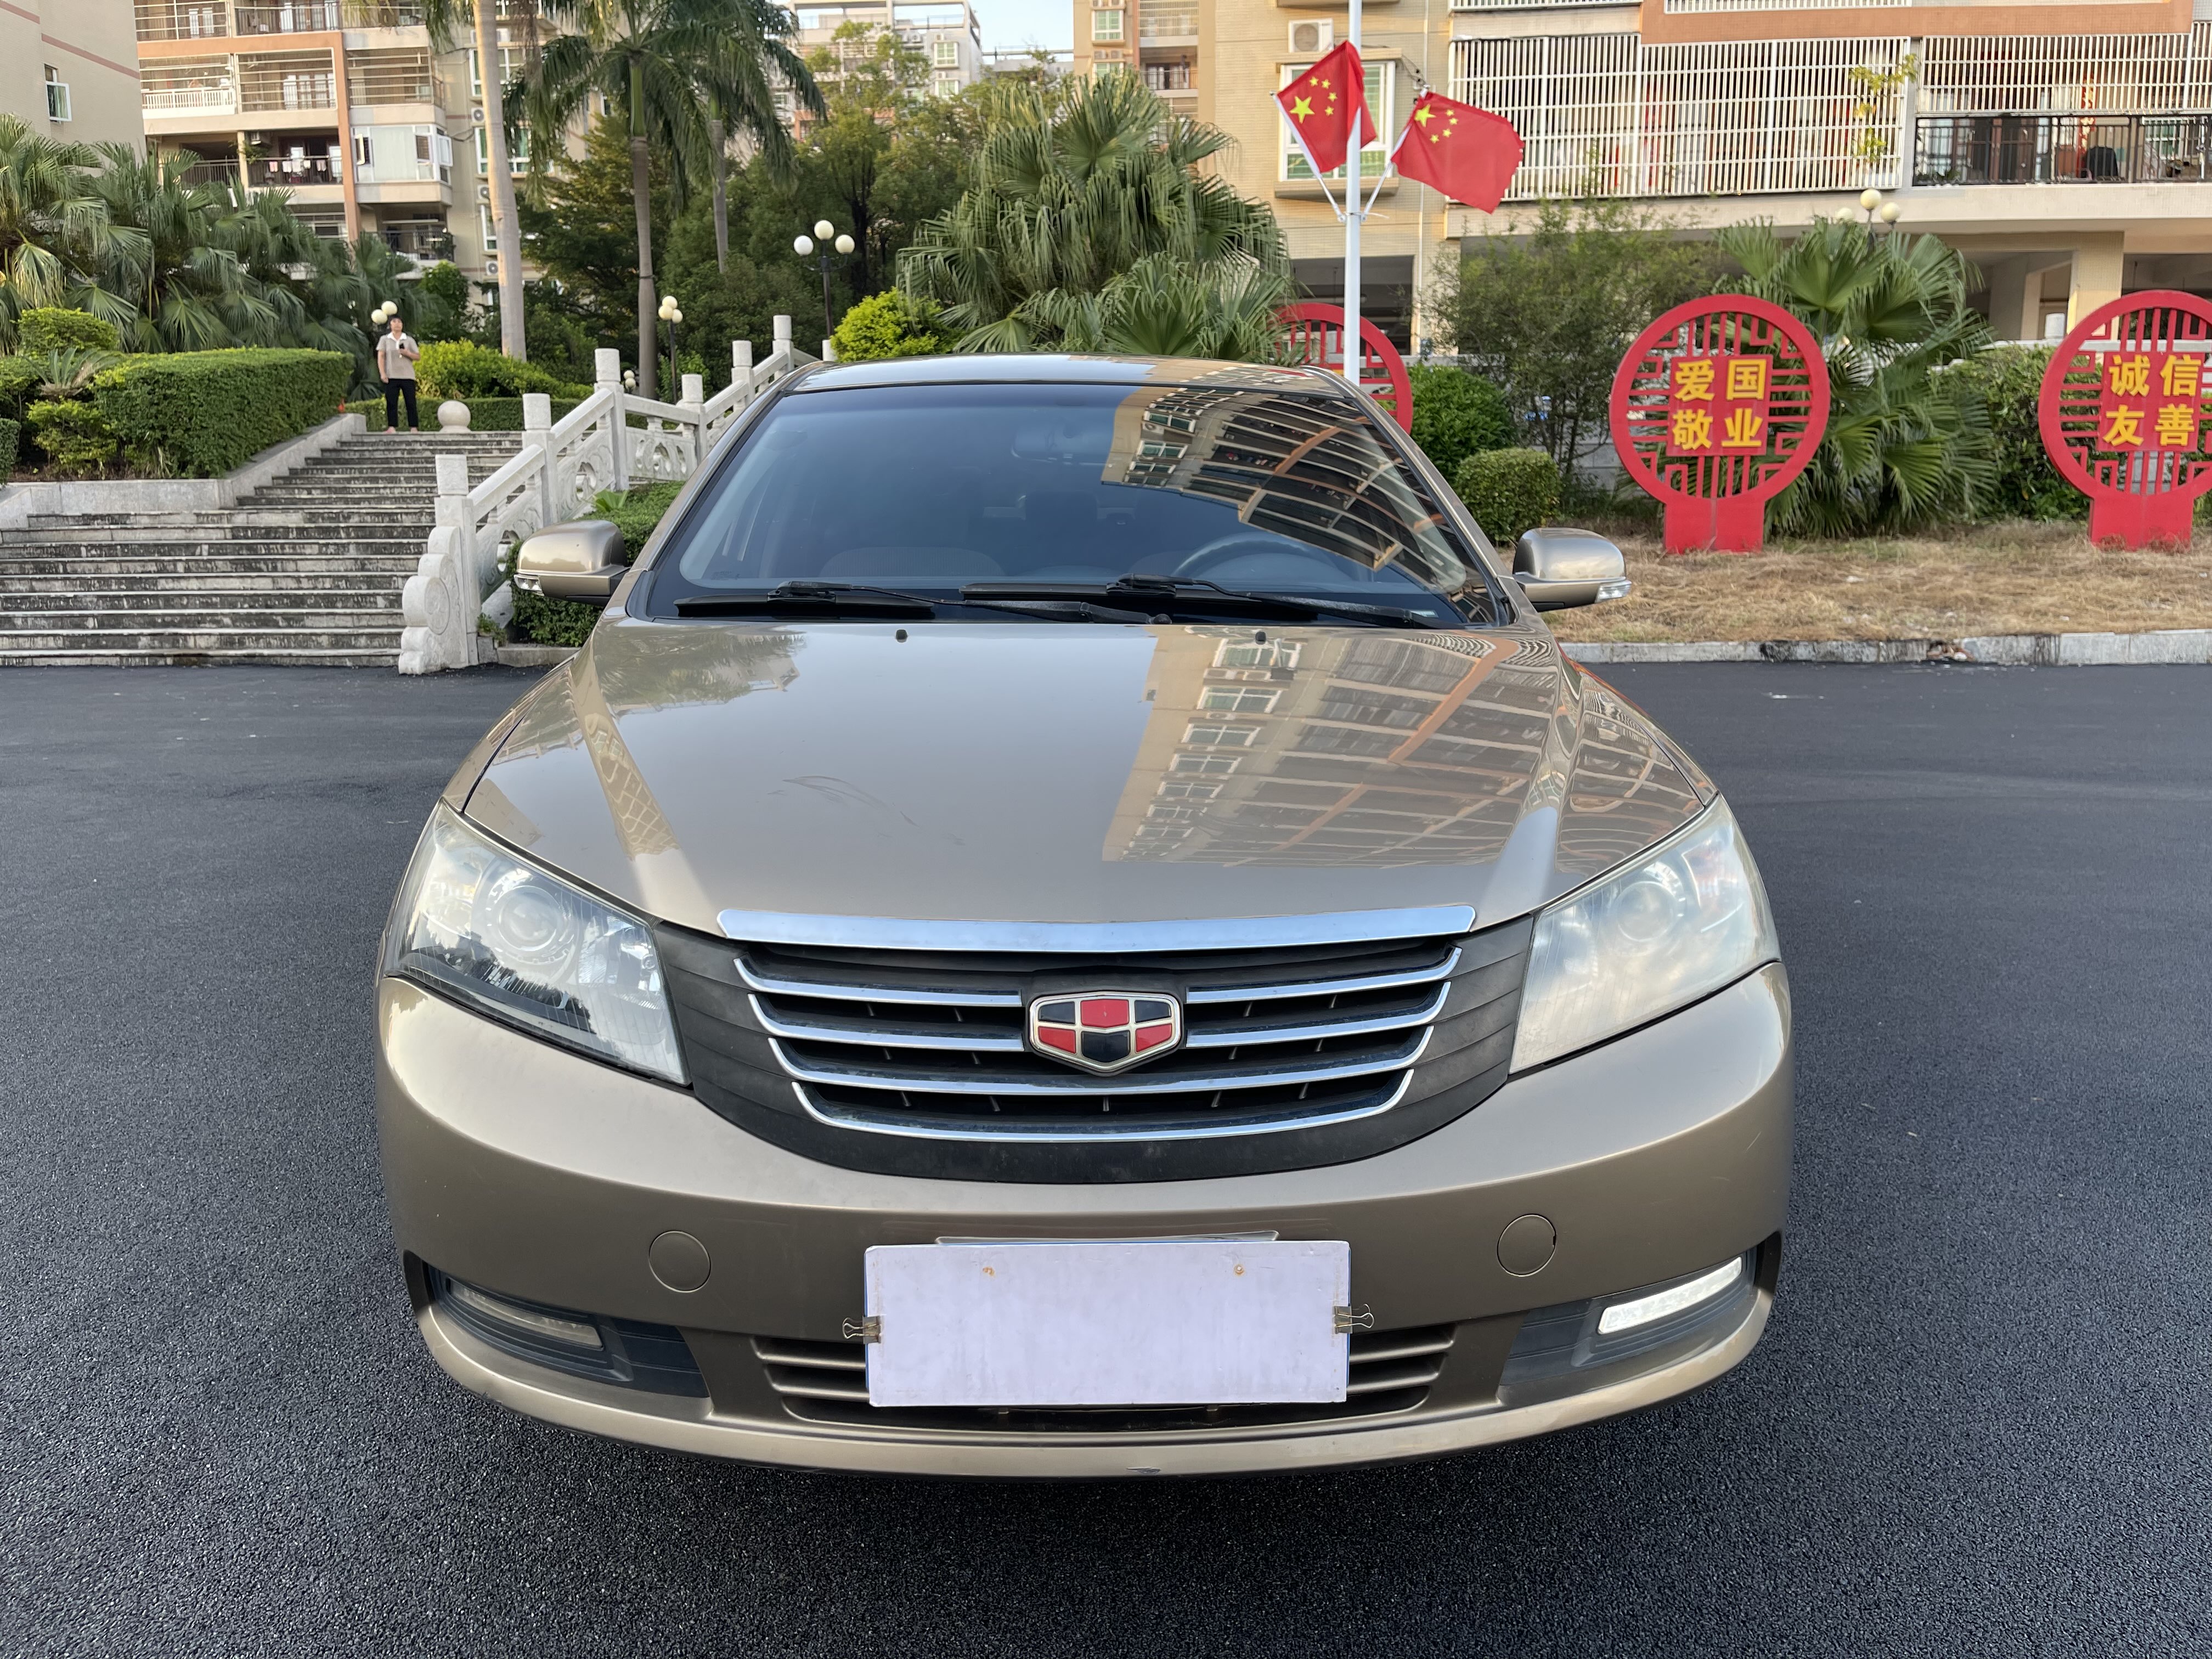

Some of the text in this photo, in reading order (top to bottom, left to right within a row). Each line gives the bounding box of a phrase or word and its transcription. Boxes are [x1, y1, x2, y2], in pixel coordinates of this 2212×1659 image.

[1674, 359, 1767, 402] 爱国
[2109, 354, 2202, 397] 诚信
[1672, 408, 1763, 450] 敬业
[2102, 403, 2195, 447] 友善
